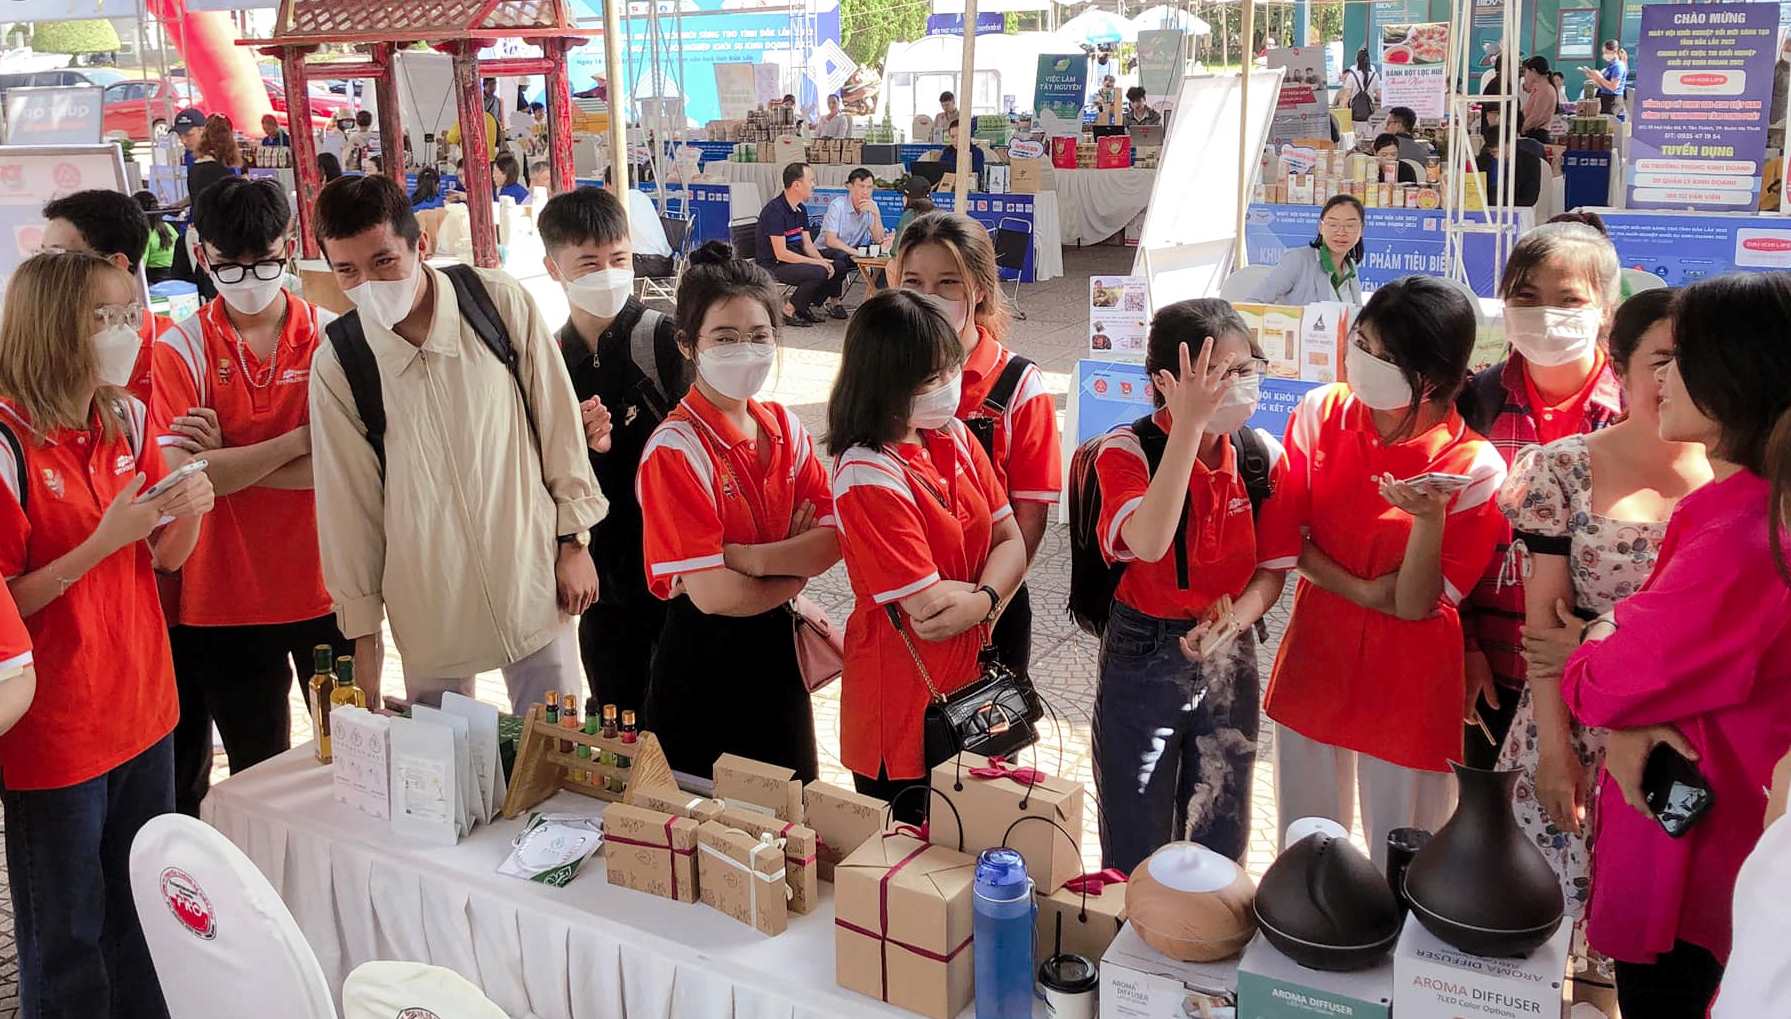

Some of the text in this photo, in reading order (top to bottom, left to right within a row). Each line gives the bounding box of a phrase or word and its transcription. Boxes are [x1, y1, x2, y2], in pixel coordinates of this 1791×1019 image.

[1674, 10, 1746, 24] CHÀO MỪNG
[1661, 141, 1734, 159] TUYỂN DỤNG
[1404, 250, 1426, 271] TIÊU
[1416, 949, 1483, 970] DIFFUSER
[1486, 963, 1544, 983] AROMA
[1272, 988, 1308, 1005] AROMA
[1309, 997, 1353, 1016] DIFFUSER
[1412, 975, 1542, 1014] AROMA DIFFUSER
[1458, 999, 1481, 1010] Color
[1483, 1004, 1516, 1019] Options
